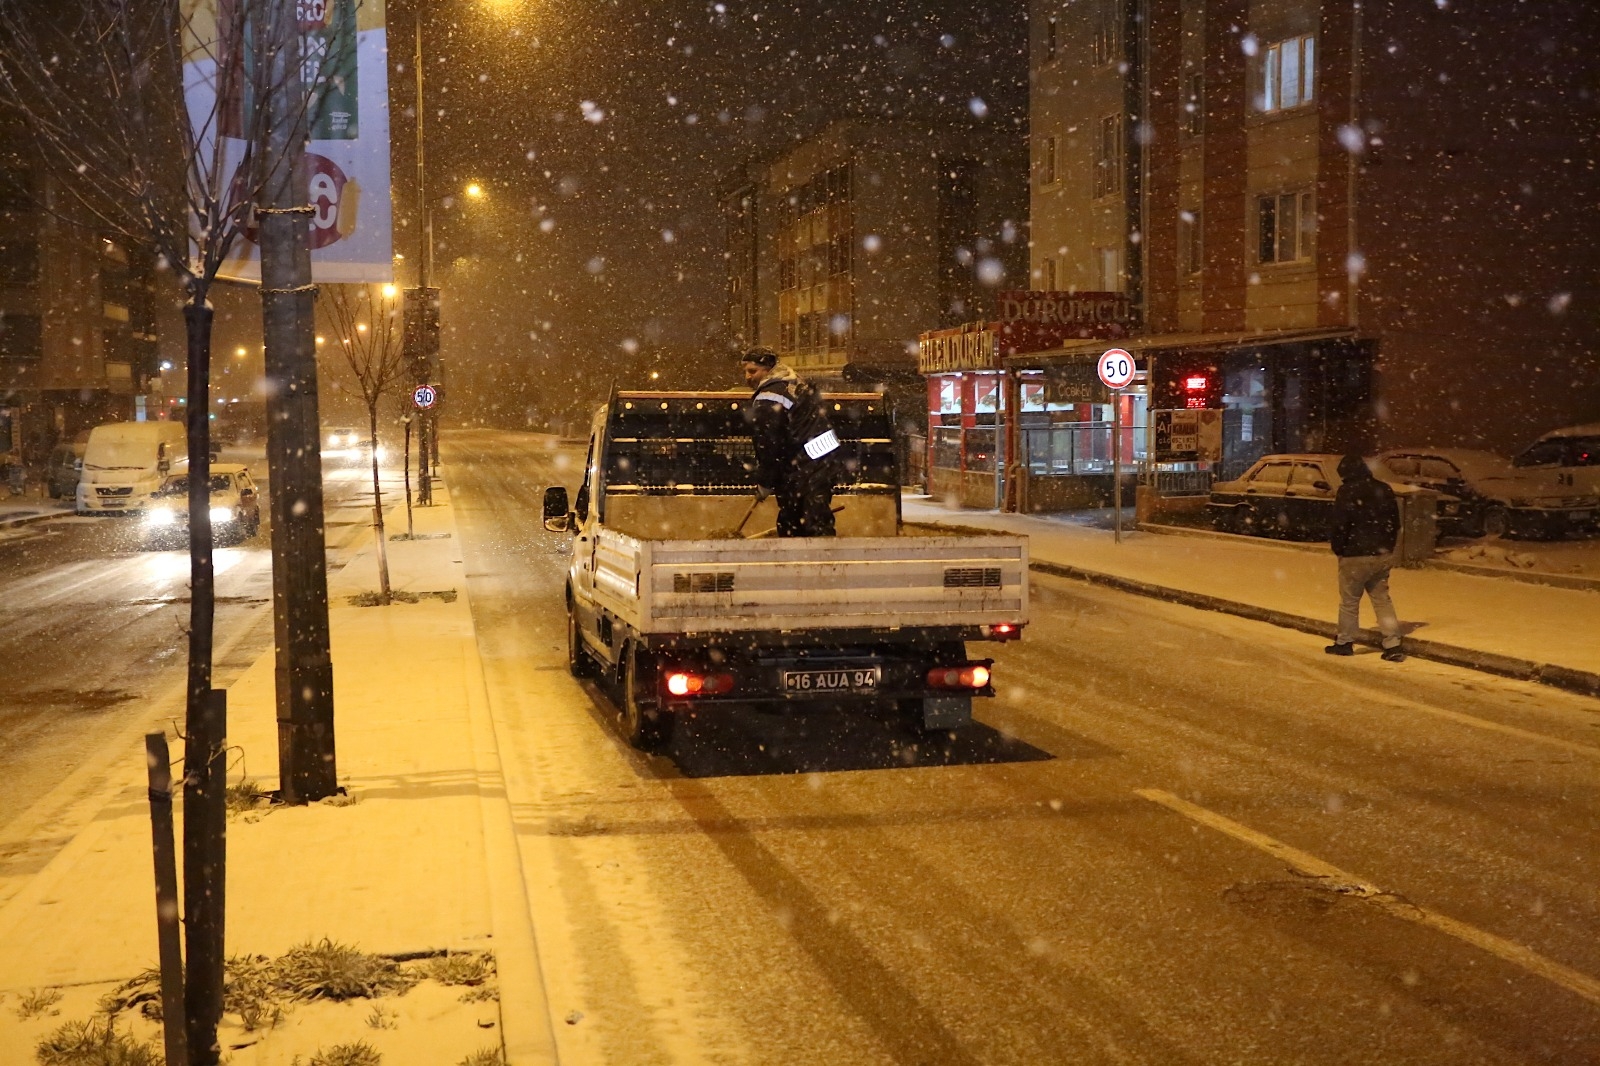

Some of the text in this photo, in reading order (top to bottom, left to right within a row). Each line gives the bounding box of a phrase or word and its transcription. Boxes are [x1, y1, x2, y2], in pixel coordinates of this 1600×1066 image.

[1106, 360, 1128, 377] 50
[417, 391, 432, 403] 50
[795, 671, 874, 690] 16 AUA 94
